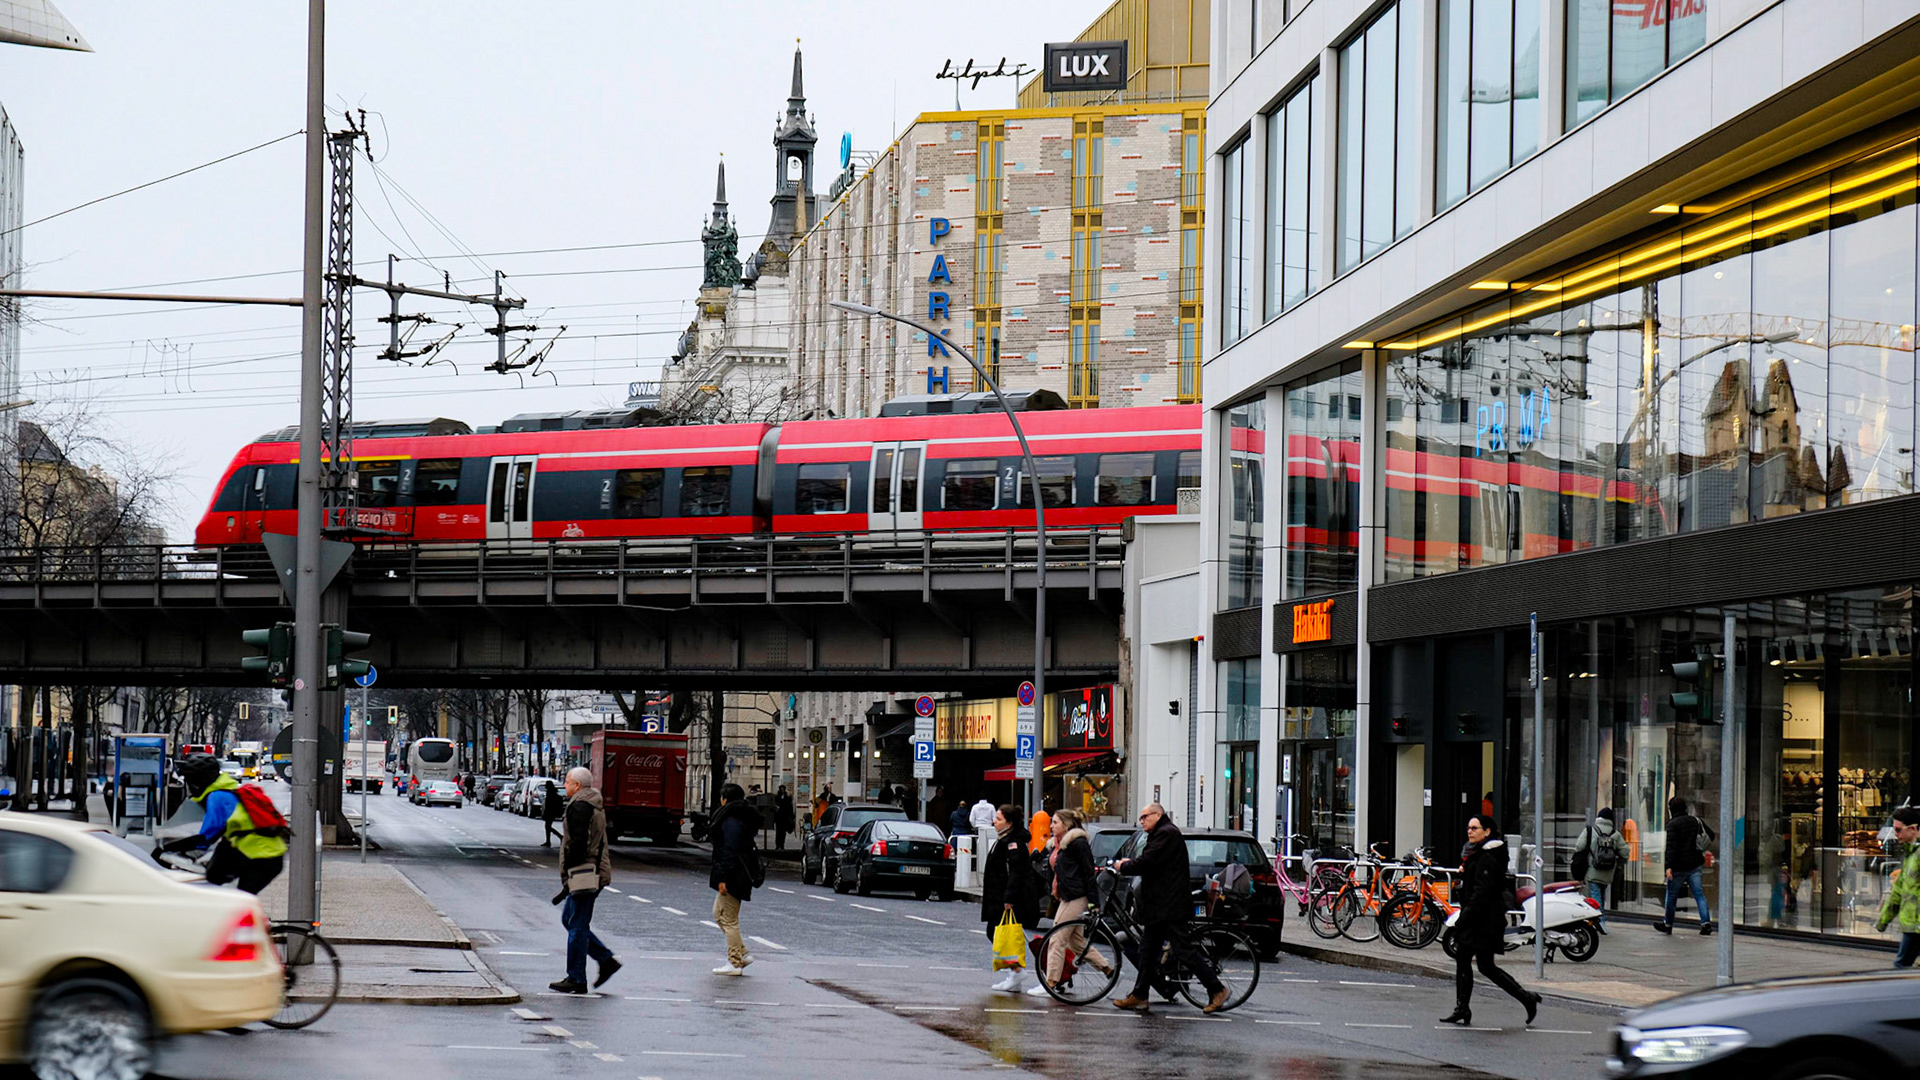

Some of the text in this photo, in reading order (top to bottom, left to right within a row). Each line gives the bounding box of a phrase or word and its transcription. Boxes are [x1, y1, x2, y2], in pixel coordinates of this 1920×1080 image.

[1060, 54, 1109, 77] LUX
[936, 57, 1036, 90] delphi
[404, 469, 411, 480] 2
[1005, 467, 1014, 480] 2
[602, 480, 610, 492] 2
[351, 513, 381, 526] EGIO
[1292, 599, 1334, 644] Hakiki
[646, 721, 659, 733] P
[917, 743, 929, 760] P
[1020, 737, 1032, 756] P
